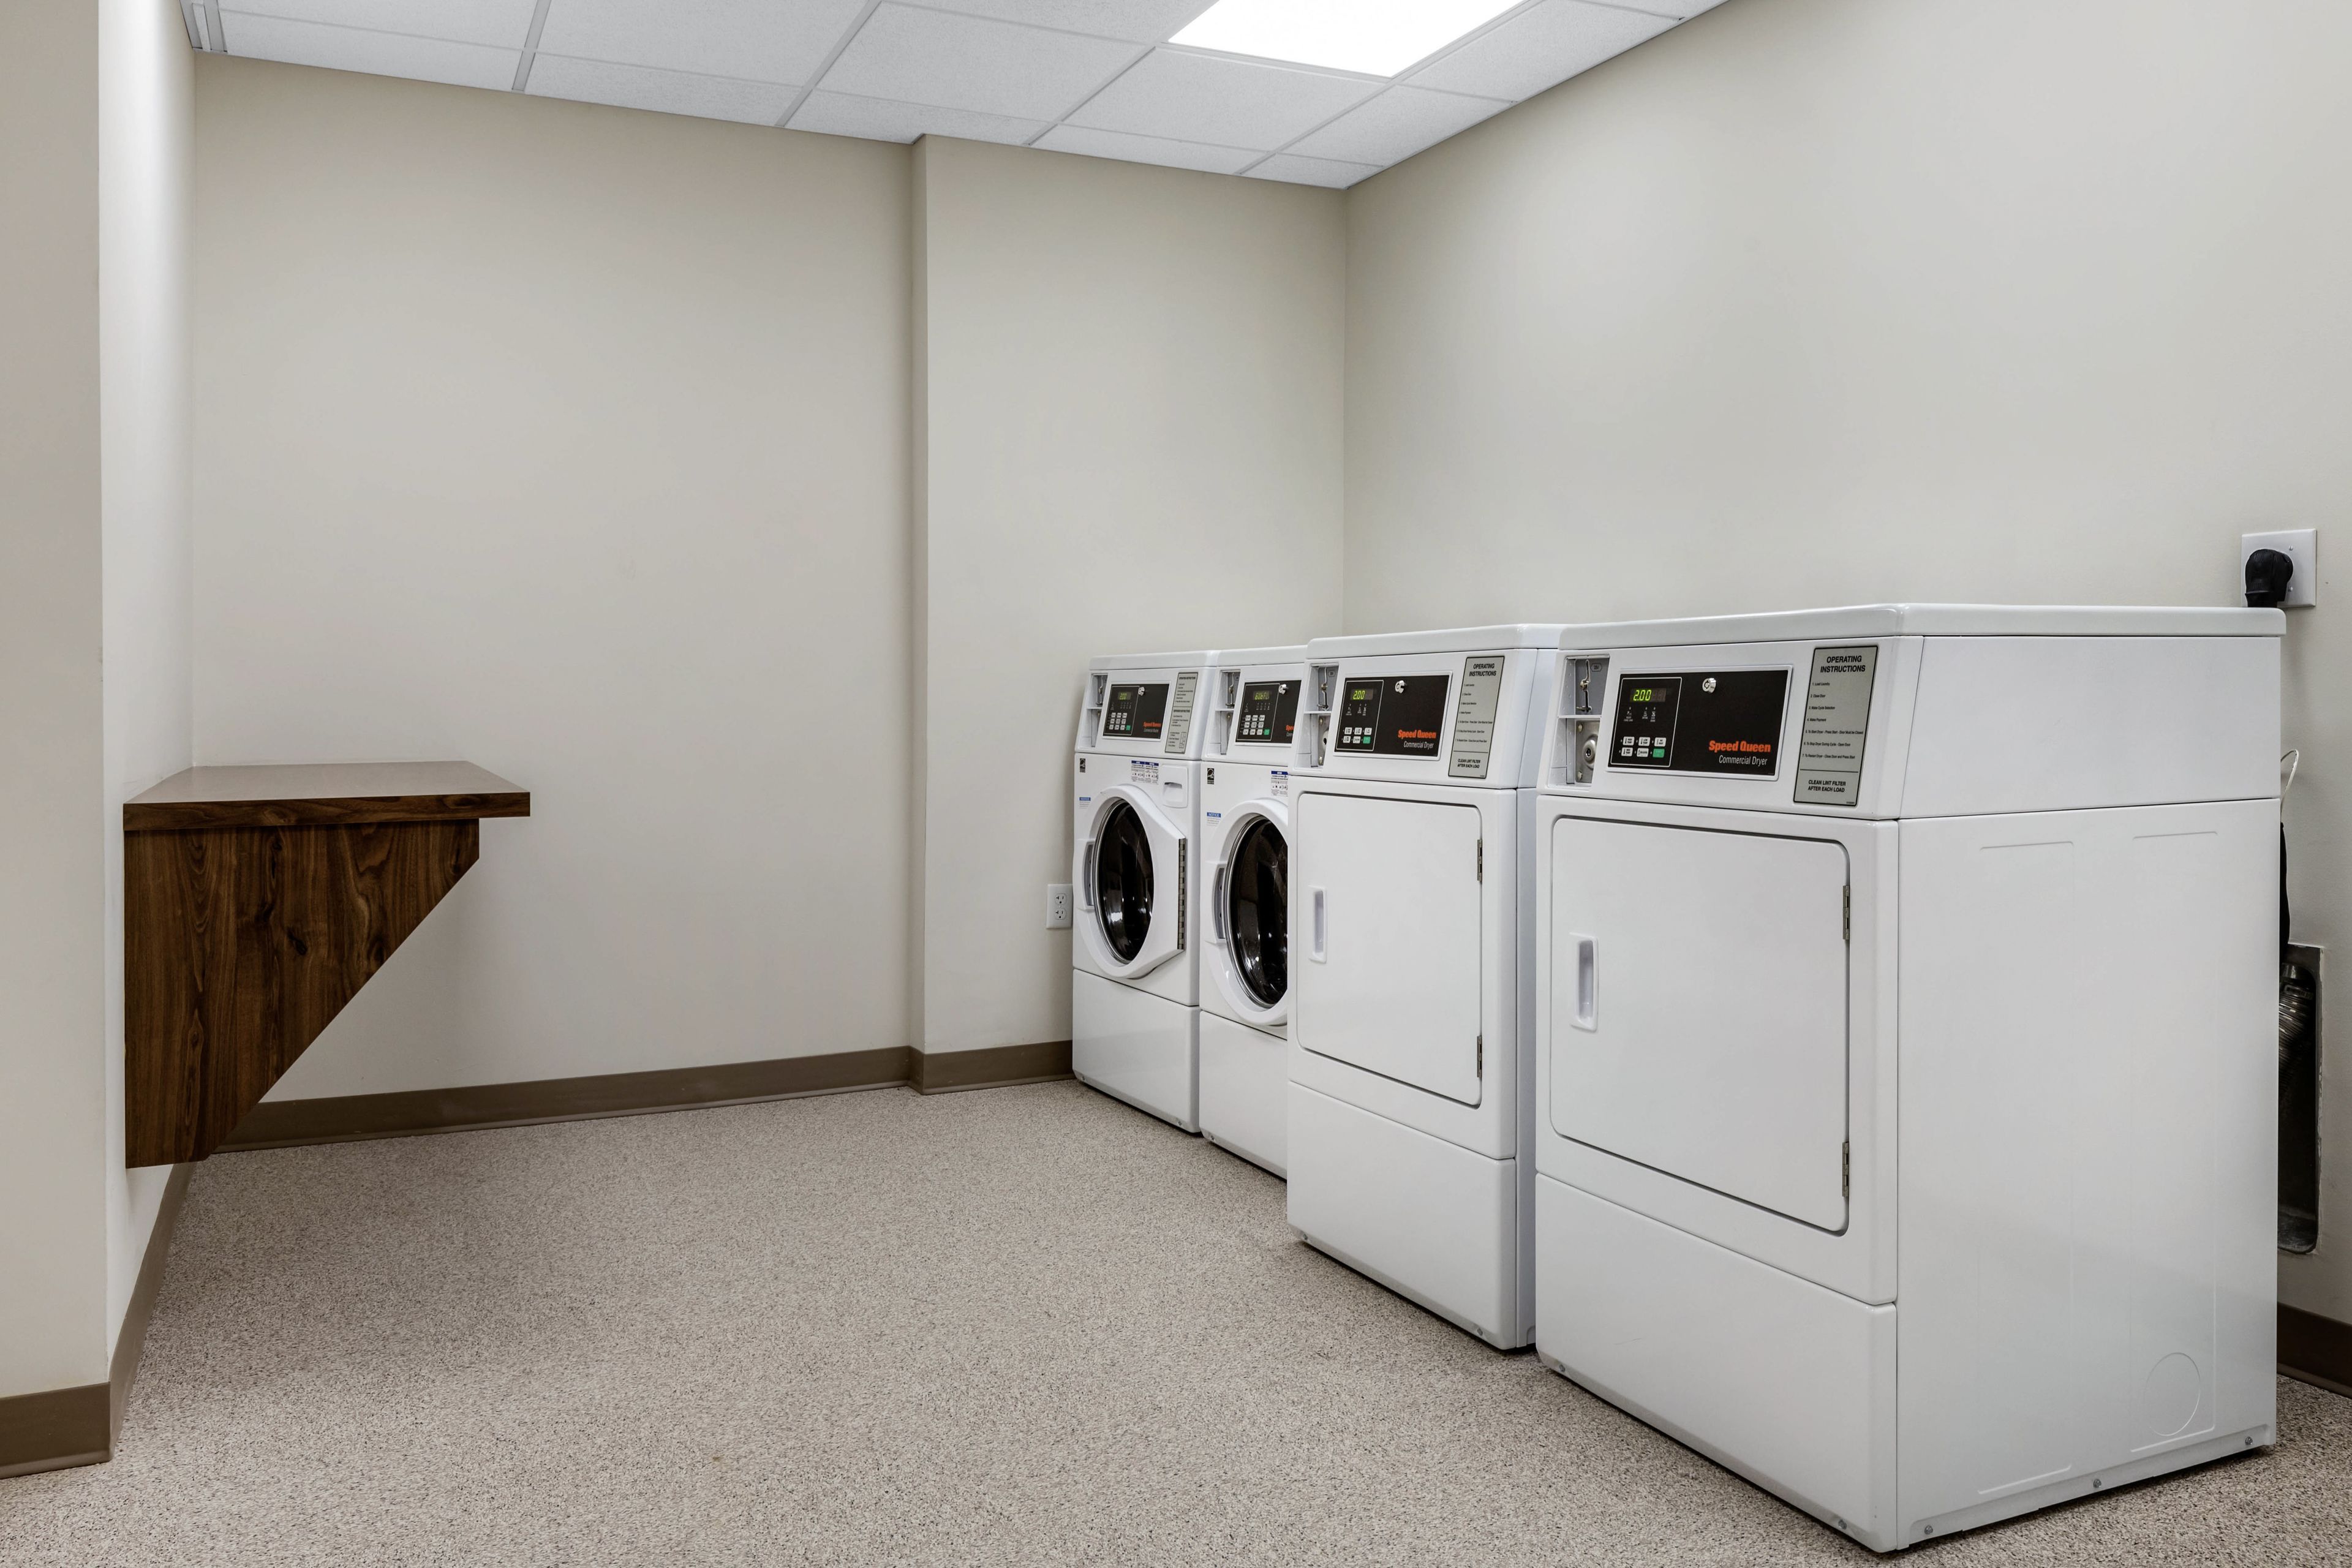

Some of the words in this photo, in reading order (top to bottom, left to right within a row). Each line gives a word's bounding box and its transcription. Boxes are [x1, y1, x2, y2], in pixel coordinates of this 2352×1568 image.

[1633, 690, 1652, 701] 2.00
[1398, 729, 1417, 739] Speed
[1417, 729, 1436, 739] Queen
[1423, 741, 1434, 750] Dryer
[1708, 740, 1739, 753] Speed
[1740, 741, 1771, 753] Queen
[1719, 755, 1751, 764] Commercial
[1752, 756, 1768, 766] Dryer
